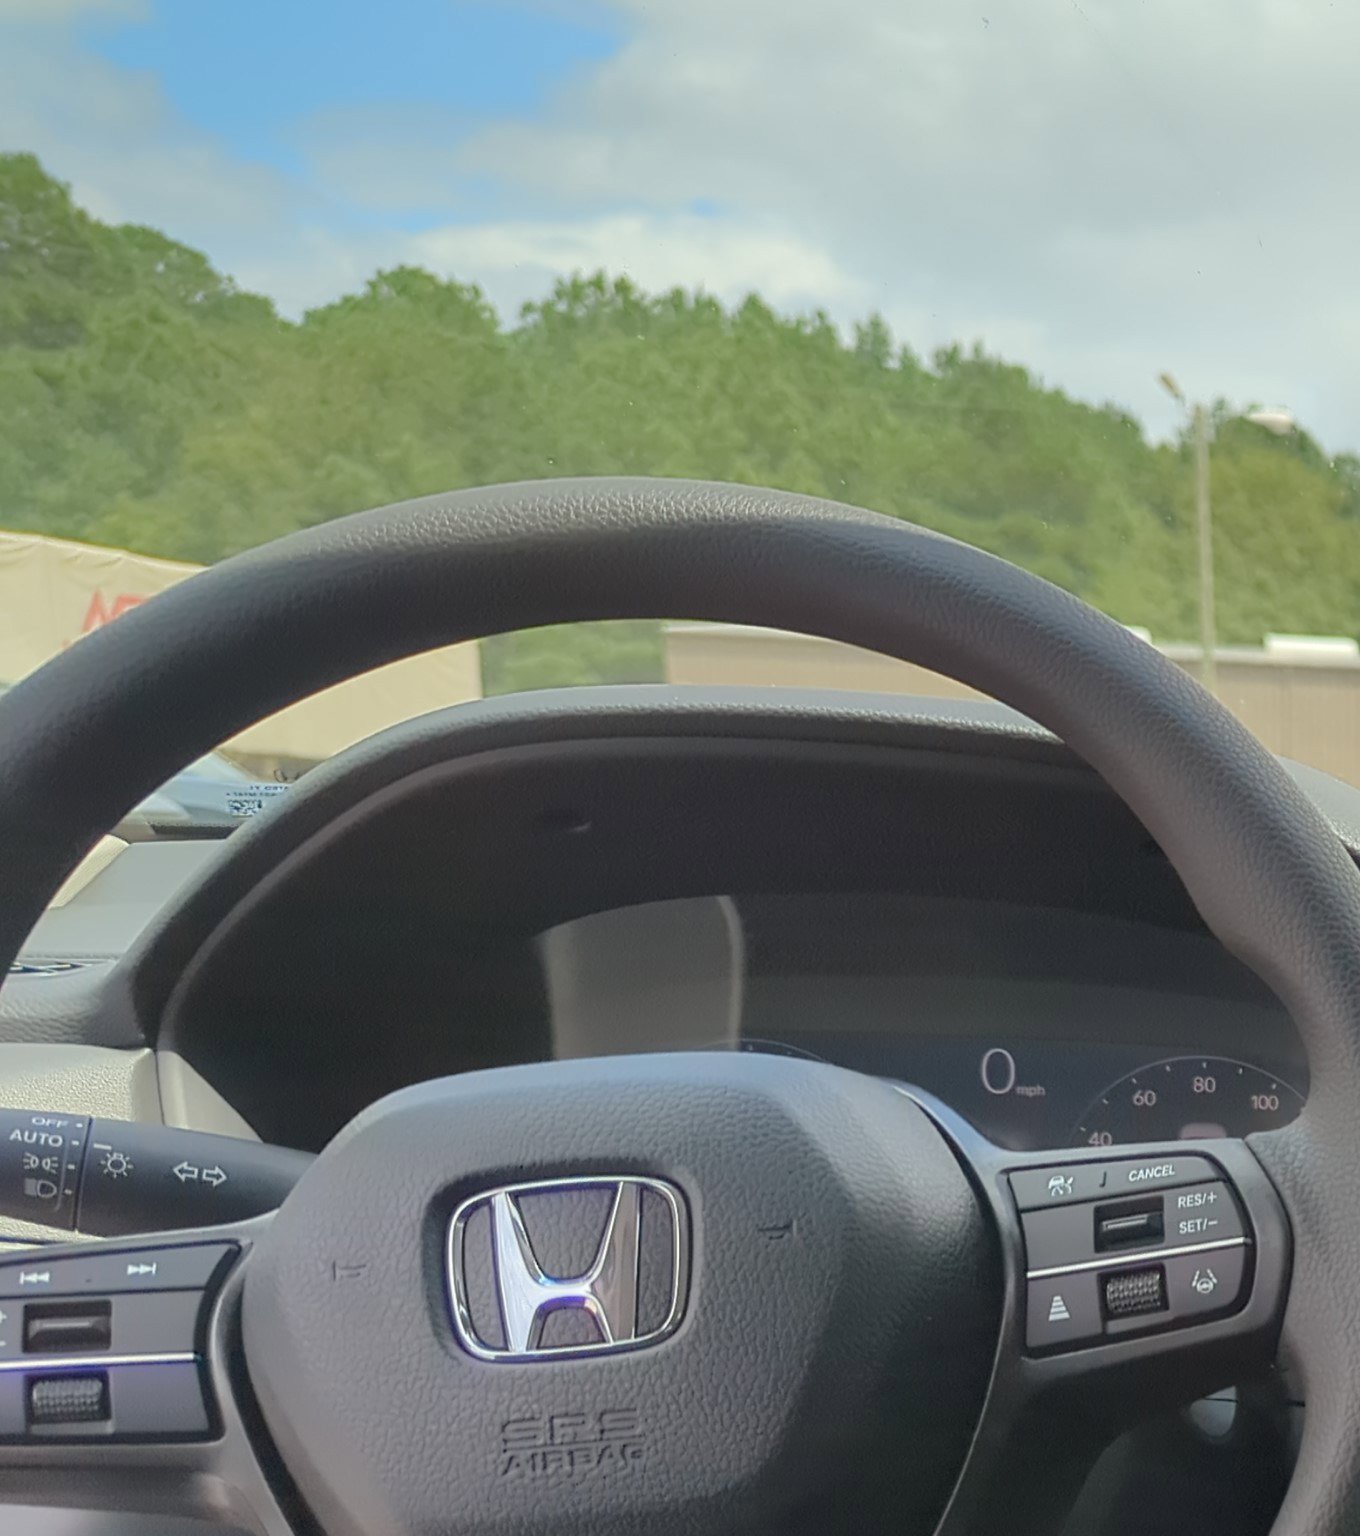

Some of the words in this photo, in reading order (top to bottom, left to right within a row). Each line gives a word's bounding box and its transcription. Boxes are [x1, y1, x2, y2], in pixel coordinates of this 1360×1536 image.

[980, 1048, 1016, 1094] 0
[1015, 1084, 1046, 1098] mph
[1192, 1077, 1217, 1094] 80
[1132, 1090, 1157, 1106] 60
[1250, 1094, 1279, 1111] 100
[31, 1116, 69, 1129] OFF
[9, 1128, 63, 1149] AUTO
[1087, 1131, 1113, 1147] 40
[1128, 1164, 1176, 1183] CANCEL
